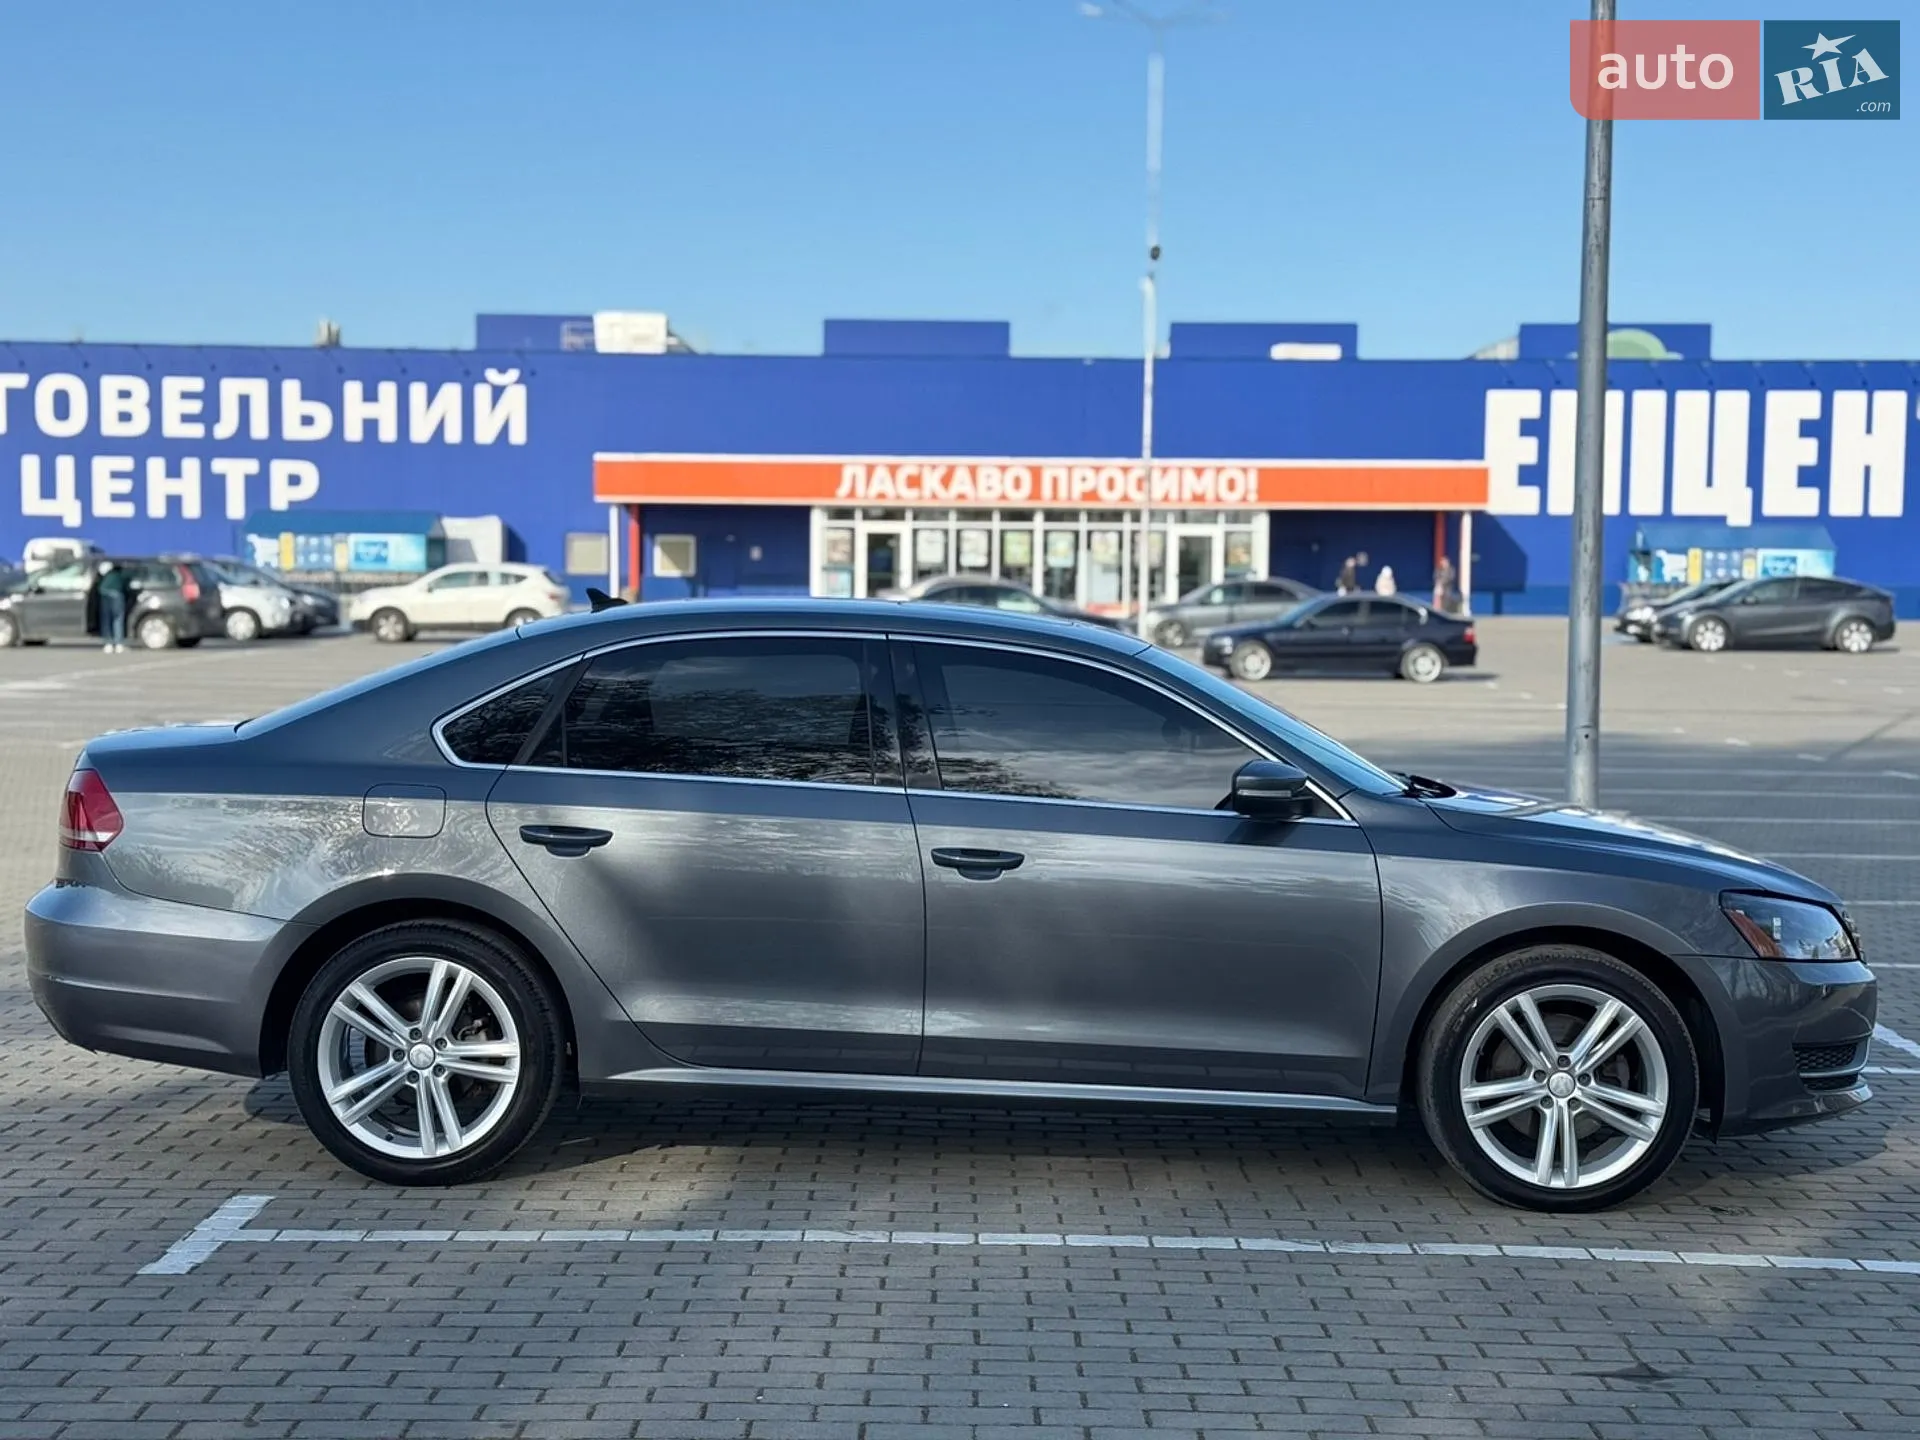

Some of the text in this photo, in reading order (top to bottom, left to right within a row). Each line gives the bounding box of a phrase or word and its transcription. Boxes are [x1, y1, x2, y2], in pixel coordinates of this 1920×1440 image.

[20, 453, 320, 528] ЦЕНТР
[835, 463, 1259, 503] ЛАСКАВО ПРОСИМО!
[1484, 388, 1920, 528] ЕПІЦЕН
